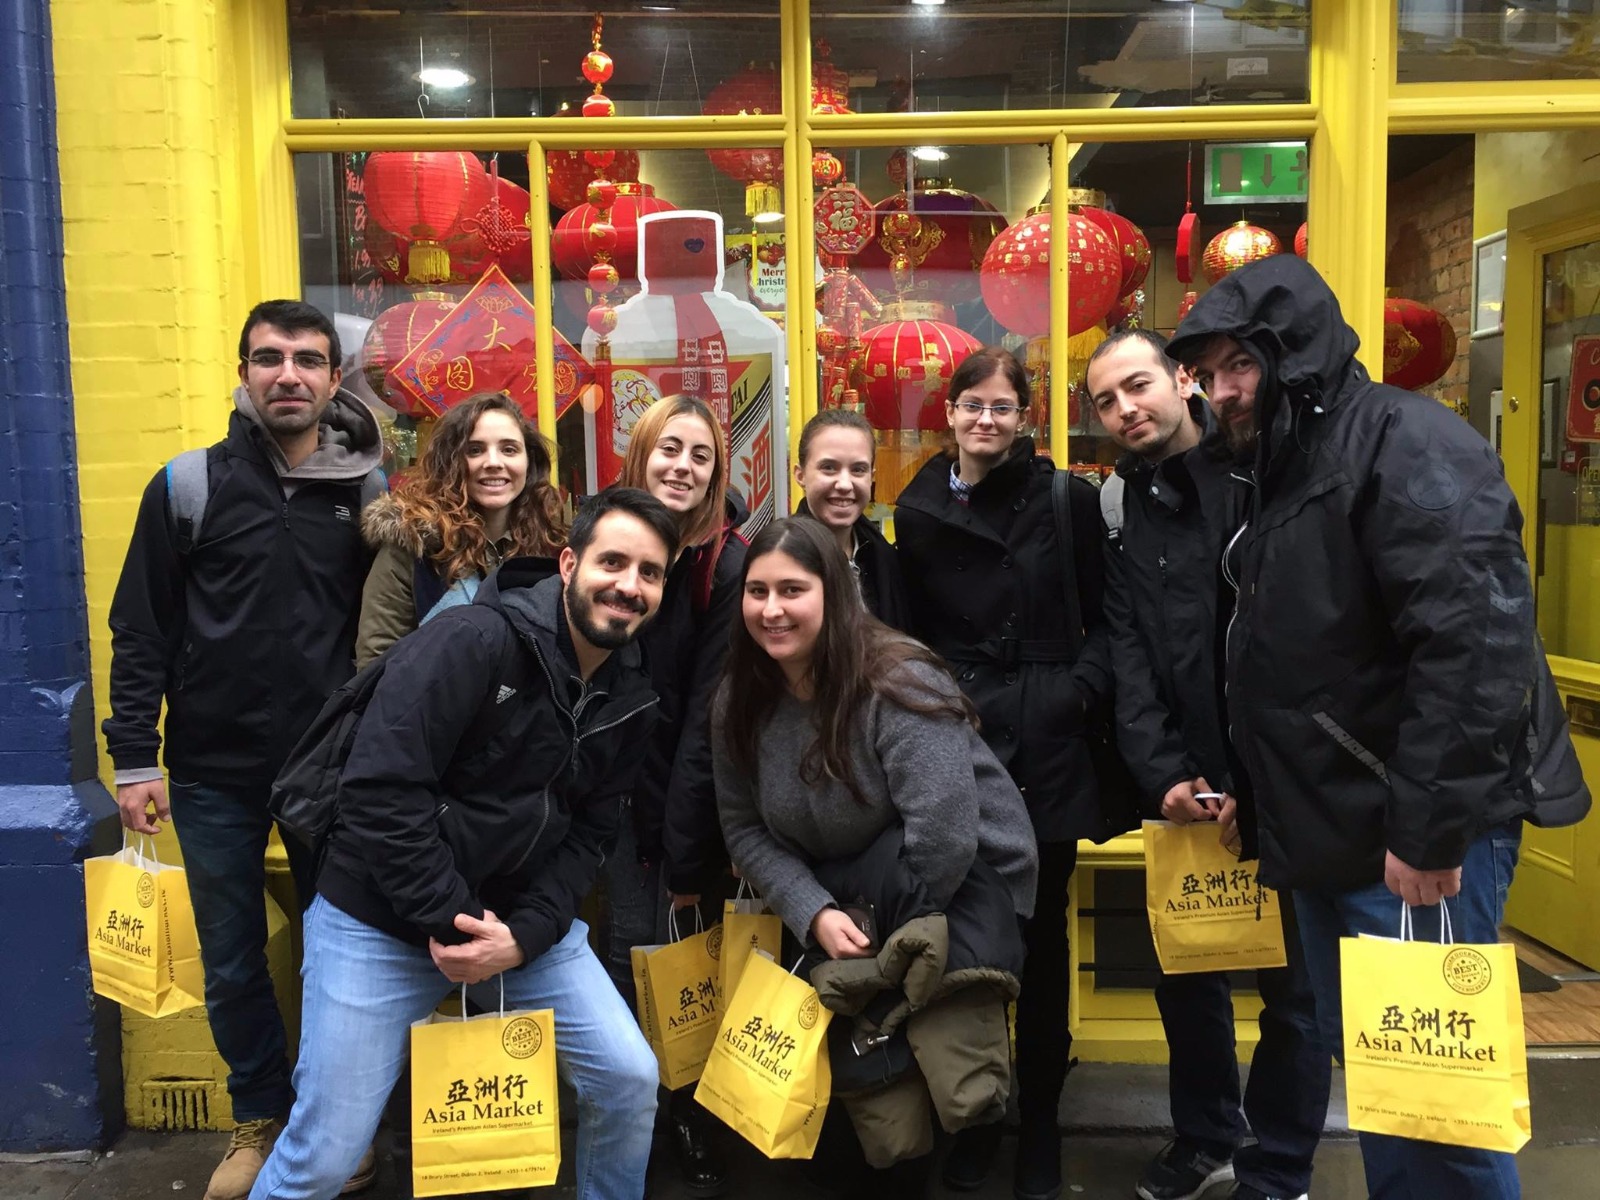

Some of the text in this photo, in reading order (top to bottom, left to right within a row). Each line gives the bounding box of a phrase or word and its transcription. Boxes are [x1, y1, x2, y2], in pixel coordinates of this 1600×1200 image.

[828, 201, 859, 231] 福
[757, 278, 785, 286] hrist
[762, 268, 785, 277] Merr
[760, 287, 785, 297] everyo
[483, 317, 512, 351] 大
[446, 355, 475, 392] 图
[496, 689, 517, 704] adidas
[1181, 869, 1252, 897] 亞洲行
[1165, 890, 1269, 913] Asia Market
[106, 910, 145, 941] 亞洲行
[95, 926, 114, 946] Asia
[116, 934, 152, 958] Market
[1453, 963, 1478, 975] BEST
[679, 976, 717, 1011] 亞洲
[667, 1009, 698, 1031] Asia
[1379, 1005, 1476, 1040] 亞洲行
[512, 1030, 531, 1042] BEST
[741, 1016, 796, 1060] 亞洲行
[1355, 1031, 1497, 1063] Asia Market
[722, 1027, 749, 1053] Asia
[748, 1044, 793, 1082] Market
[1393, 1057, 1421, 1066] Premium
[1441, 1063, 1484, 1073] Supermarket
[445, 1074, 528, 1106] 亞洲行
[422, 1099, 544, 1124] Asia Market
[457, 1124, 481, 1132] Premium
